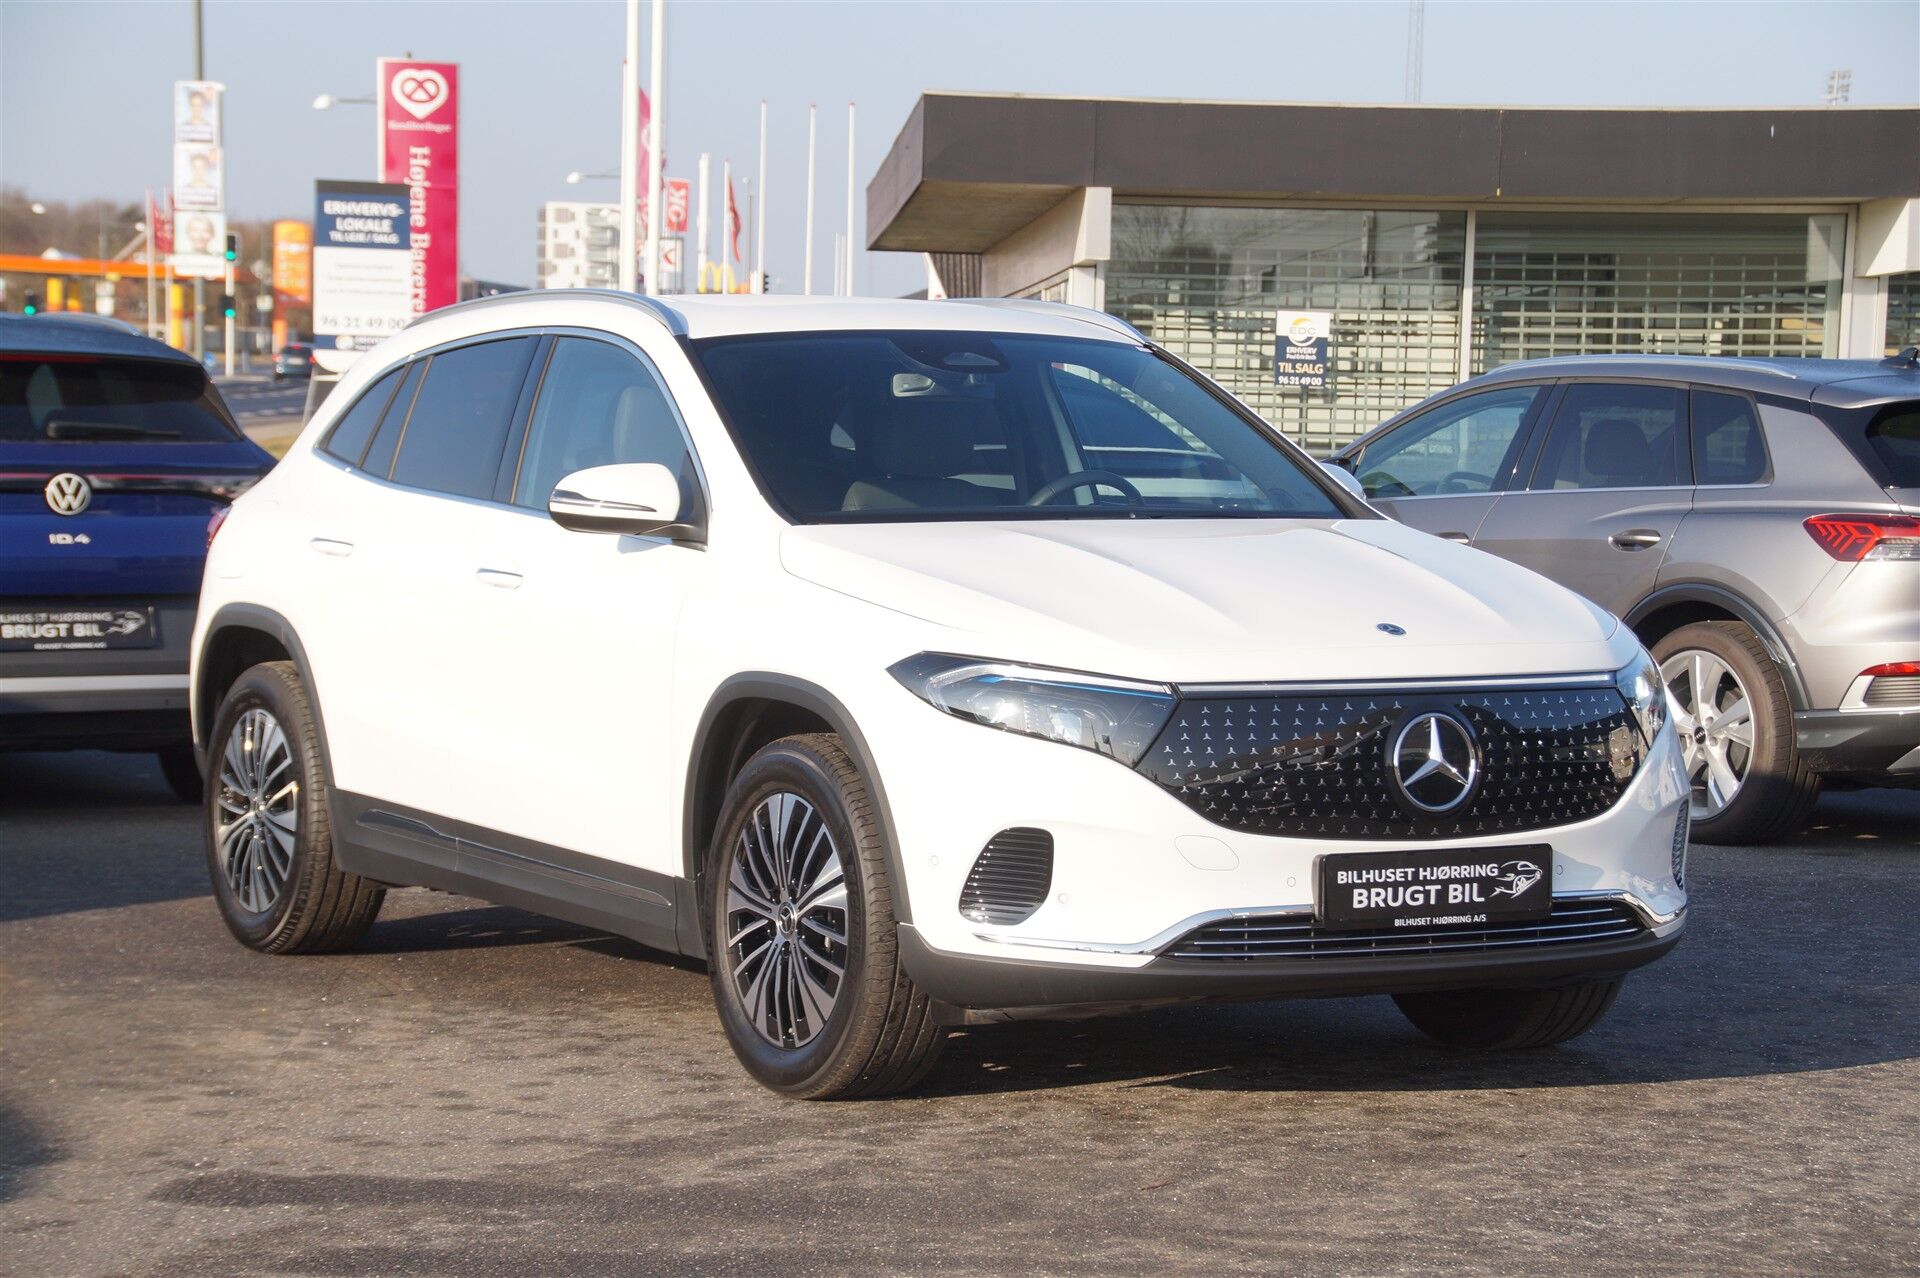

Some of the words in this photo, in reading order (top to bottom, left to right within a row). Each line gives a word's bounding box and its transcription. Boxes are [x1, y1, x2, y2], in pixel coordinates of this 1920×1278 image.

[324, 200, 404, 217] ERHVERVS-
[336, 217, 393, 233] LOKALE
[1289, 327, 1317, 335] EDC
[1286, 346, 1317, 354] ERHVERV
[1278, 362, 1294, 373] TIL
[1295, 362, 1324, 375] SALG
[1278, 375, 1288, 384] 96
[1289, 376, 1299, 385] 31
[1300, 376, 1310, 385] 49
[1311, 377, 1322, 386] 00
[1, 623, 70, 638] BRUGT
[73, 623, 104, 637] BIL
[1337, 868, 1415, 884] BILHUSET
[1419, 863, 1499, 880] HJØRRING
[1352, 885, 1442, 909] BRUGT
[1448, 882, 1485, 904] BIL
[1394, 917, 1431, 927] BILHUSET
[1432, 915, 1472, 925] HJØRRING
[1473, 914, 1487, 923] A/S
